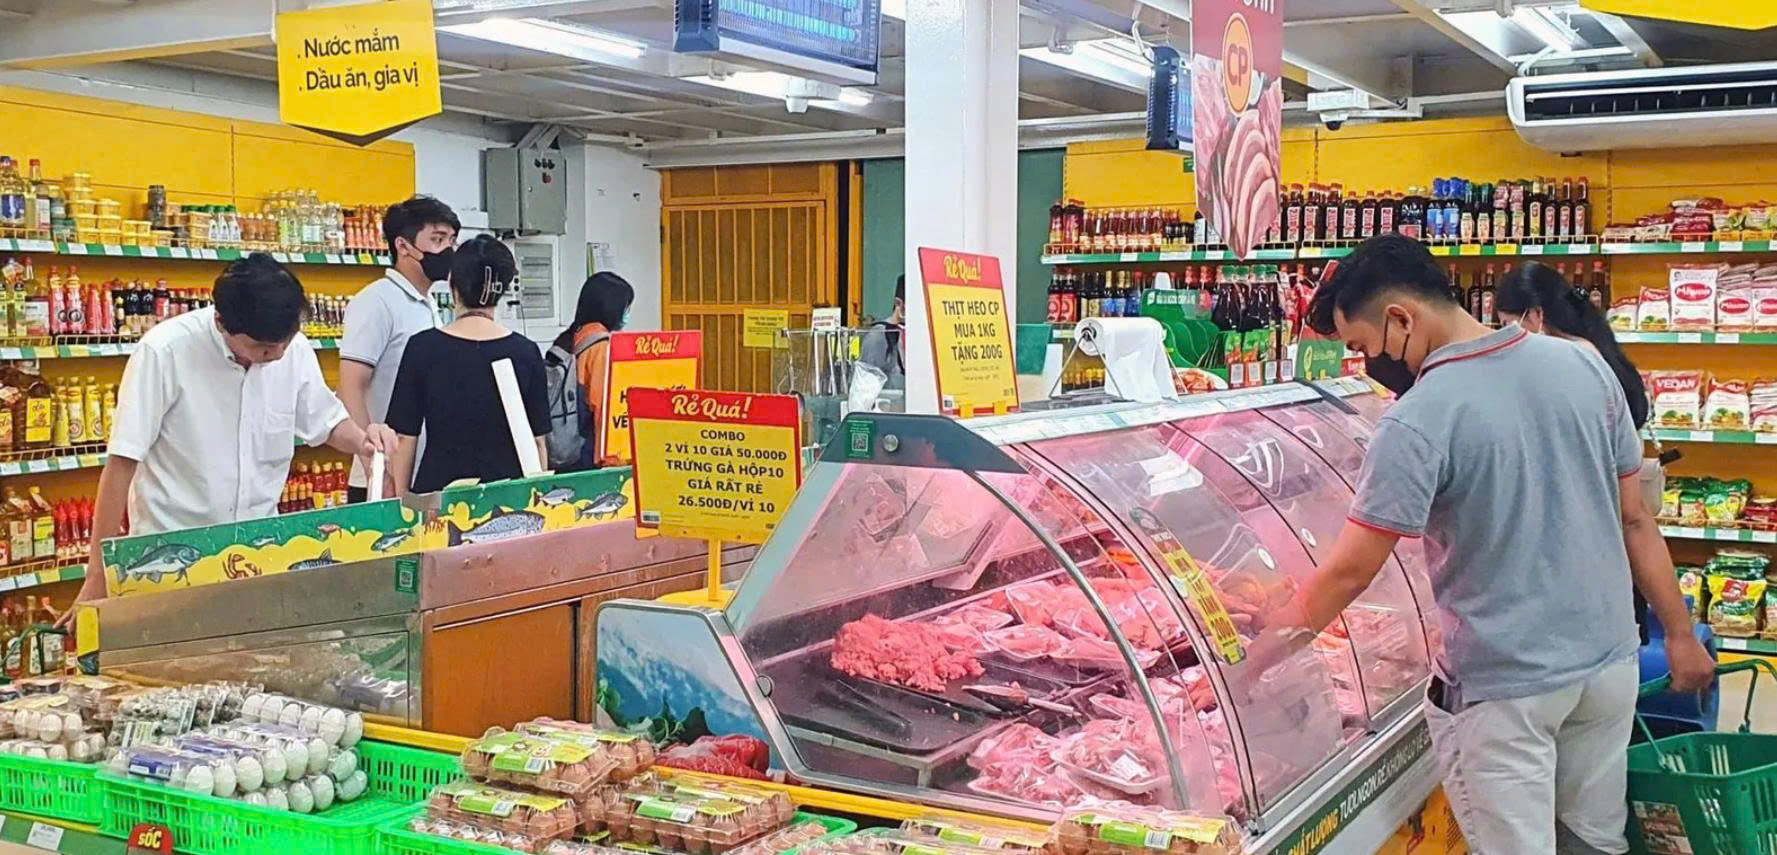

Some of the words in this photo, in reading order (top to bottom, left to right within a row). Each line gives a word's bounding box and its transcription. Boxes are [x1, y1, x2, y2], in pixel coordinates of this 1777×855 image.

[304, 36, 351, 58] Nước
[355, 27, 400, 53] mắm
[306, 67, 341, 91] Dầu
[344, 67, 371, 88] ăn,
[374, 64, 400, 91] gia
[403, 61, 419, 87] vị
[1227, 43, 1249, 88] CP
[942, 300, 965, 320] THỊT
[967, 301, 986, 316] HEO
[988, 301, 1000, 316] CP
[954, 323, 976, 338] MUA
[977, 323, 996, 338] 1KG
[951, 341, 978, 365] TẶNG
[980, 344, 1003, 360] 200G
[672, 394, 700, 415] Rẻ
[701, 396, 752, 420] Quá!
[700, 429, 745, 441] COMBO
[665, 443, 672, 453] 2
[693, 445, 707, 455] 10
[736, 448, 787, 460] 50.000Đ
[666, 457, 712, 473] TRỨNG
[716, 461, 735, 474] GÀ
[739, 462, 784, 478] HỘP10
[759, 502, 775, 513] 10
